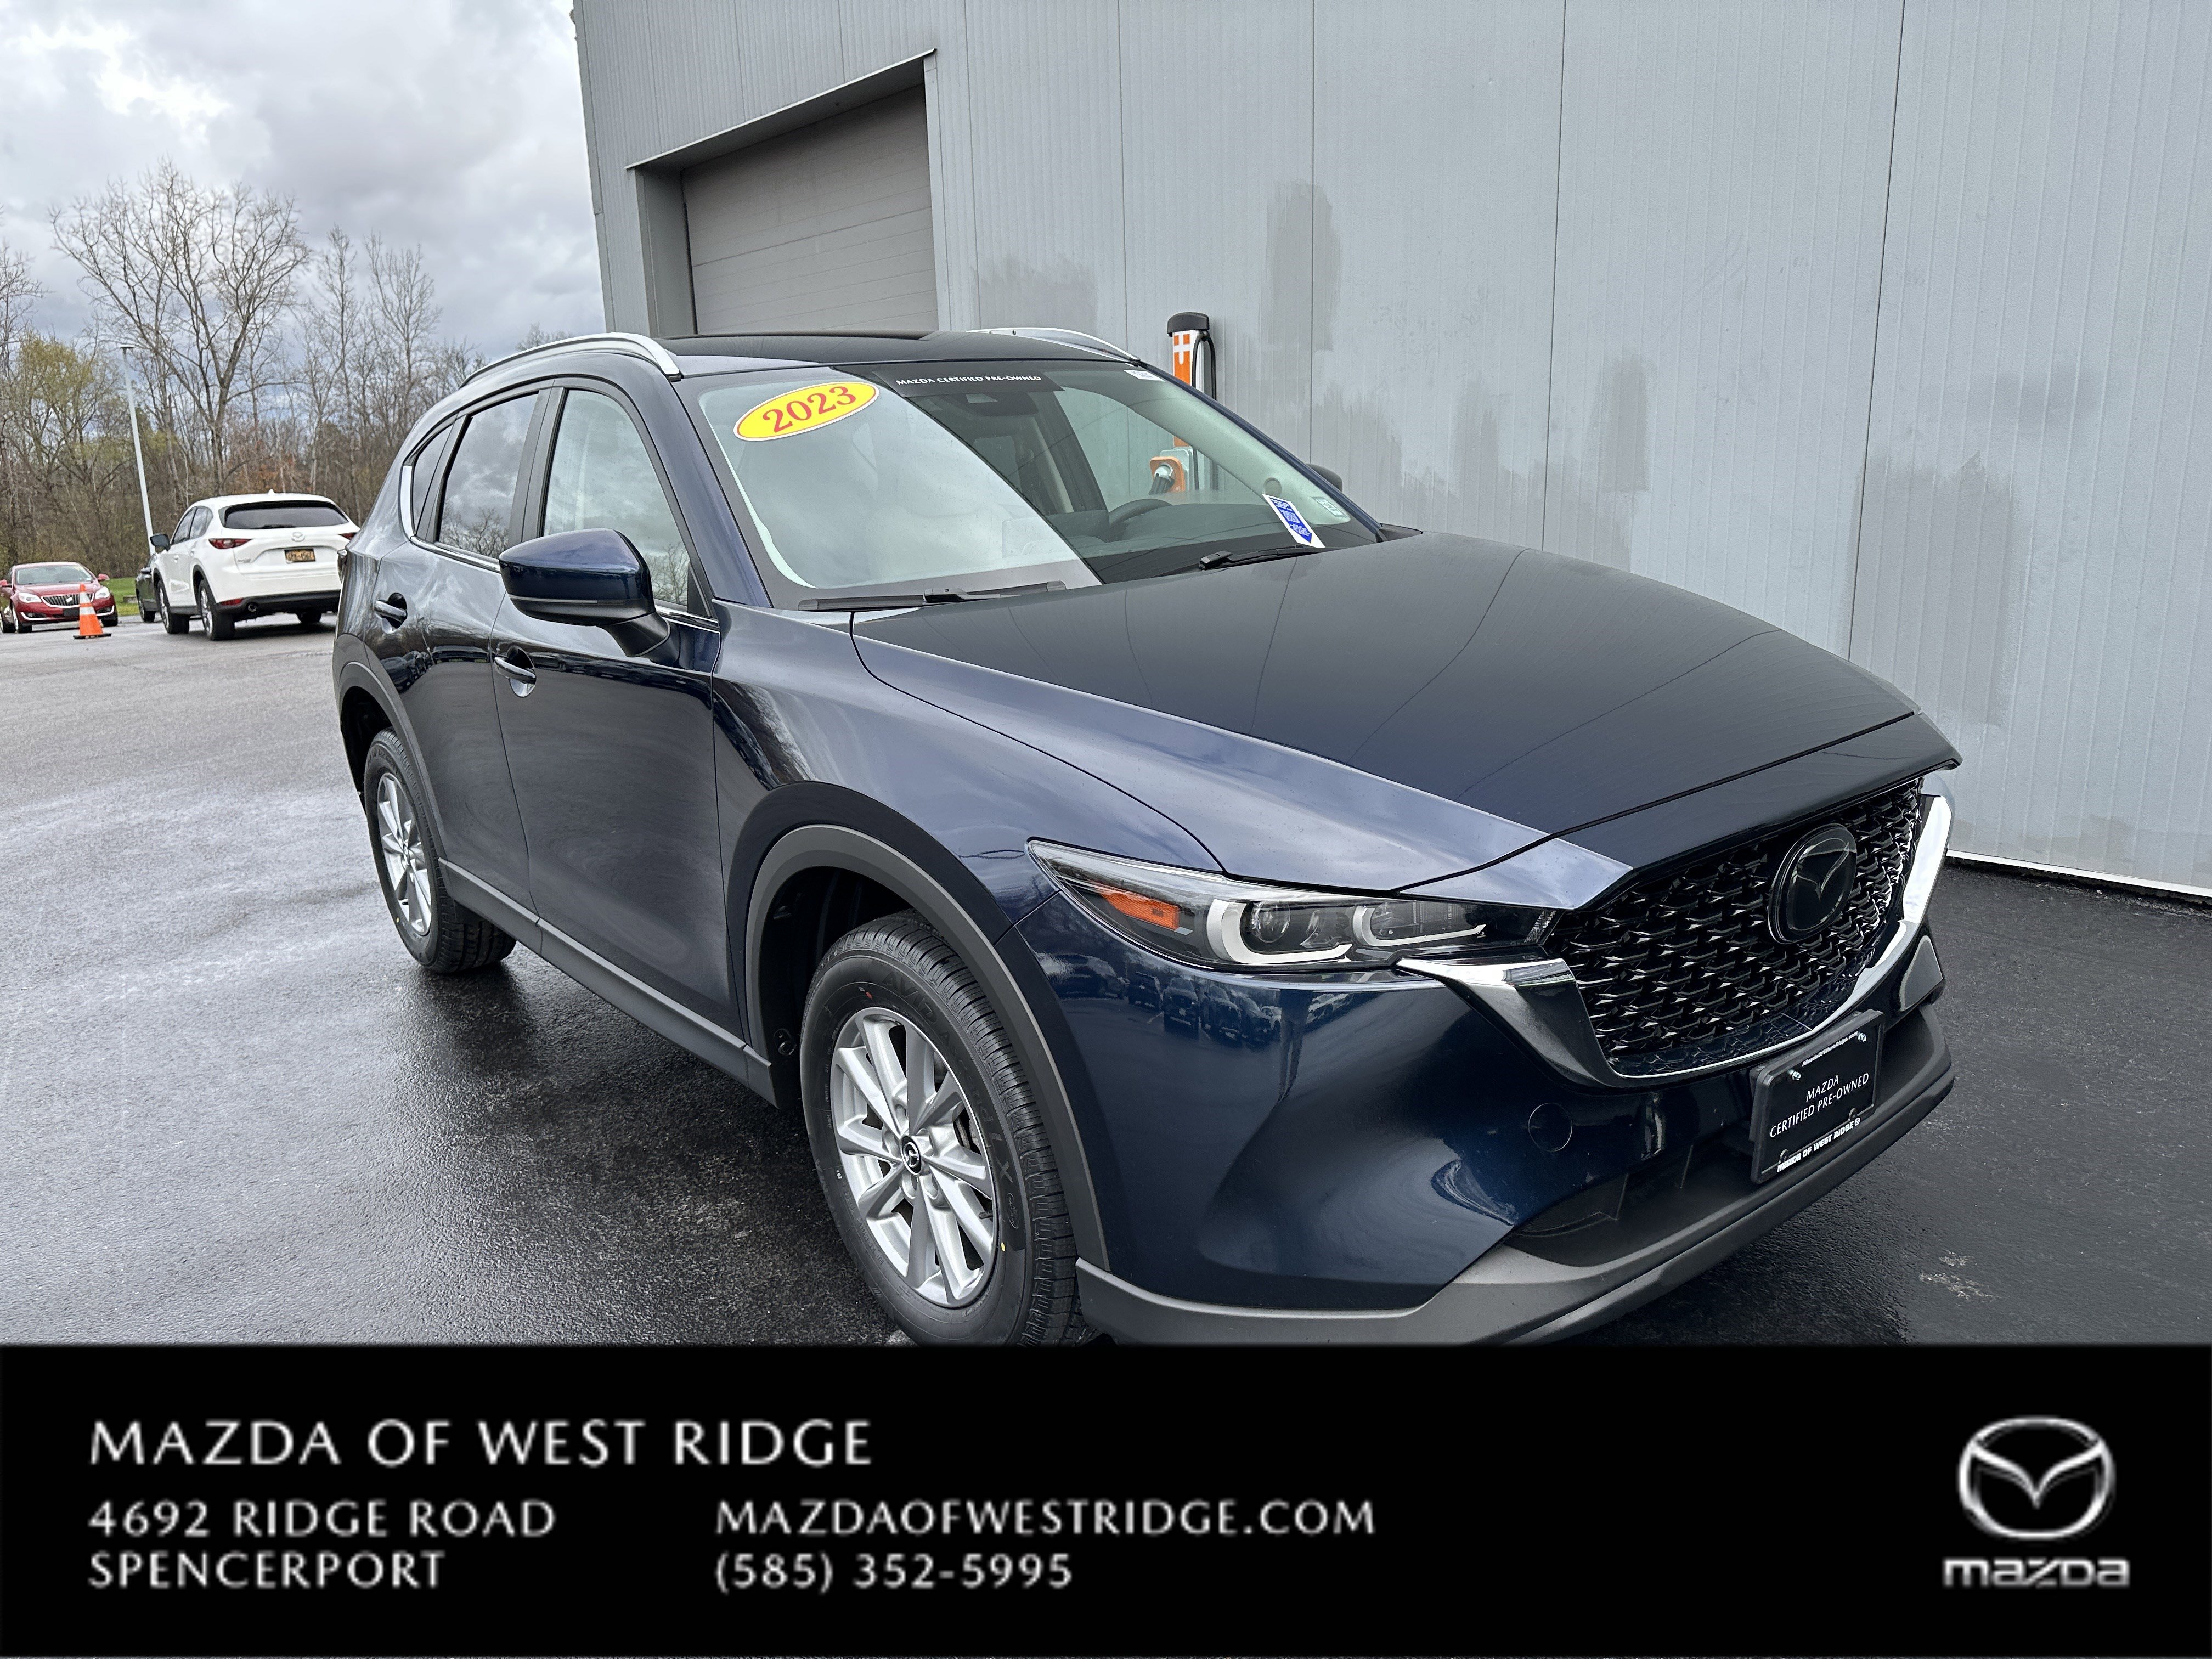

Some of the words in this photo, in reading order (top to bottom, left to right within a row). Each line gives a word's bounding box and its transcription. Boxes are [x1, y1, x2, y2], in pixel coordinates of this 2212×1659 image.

[763, 386, 856, 433] 2023
[1770, 1104, 1815, 1138] CERTIFIED
[1817, 1073, 1869, 1111] PRE-OWNED
[1806, 1075, 1838, 1102] MAZDA
[1802, 1146, 1812, 1158] OF
[1813, 1133, 1833, 1152] WEST
[1833, 1121, 1854, 1139] RIDGE
